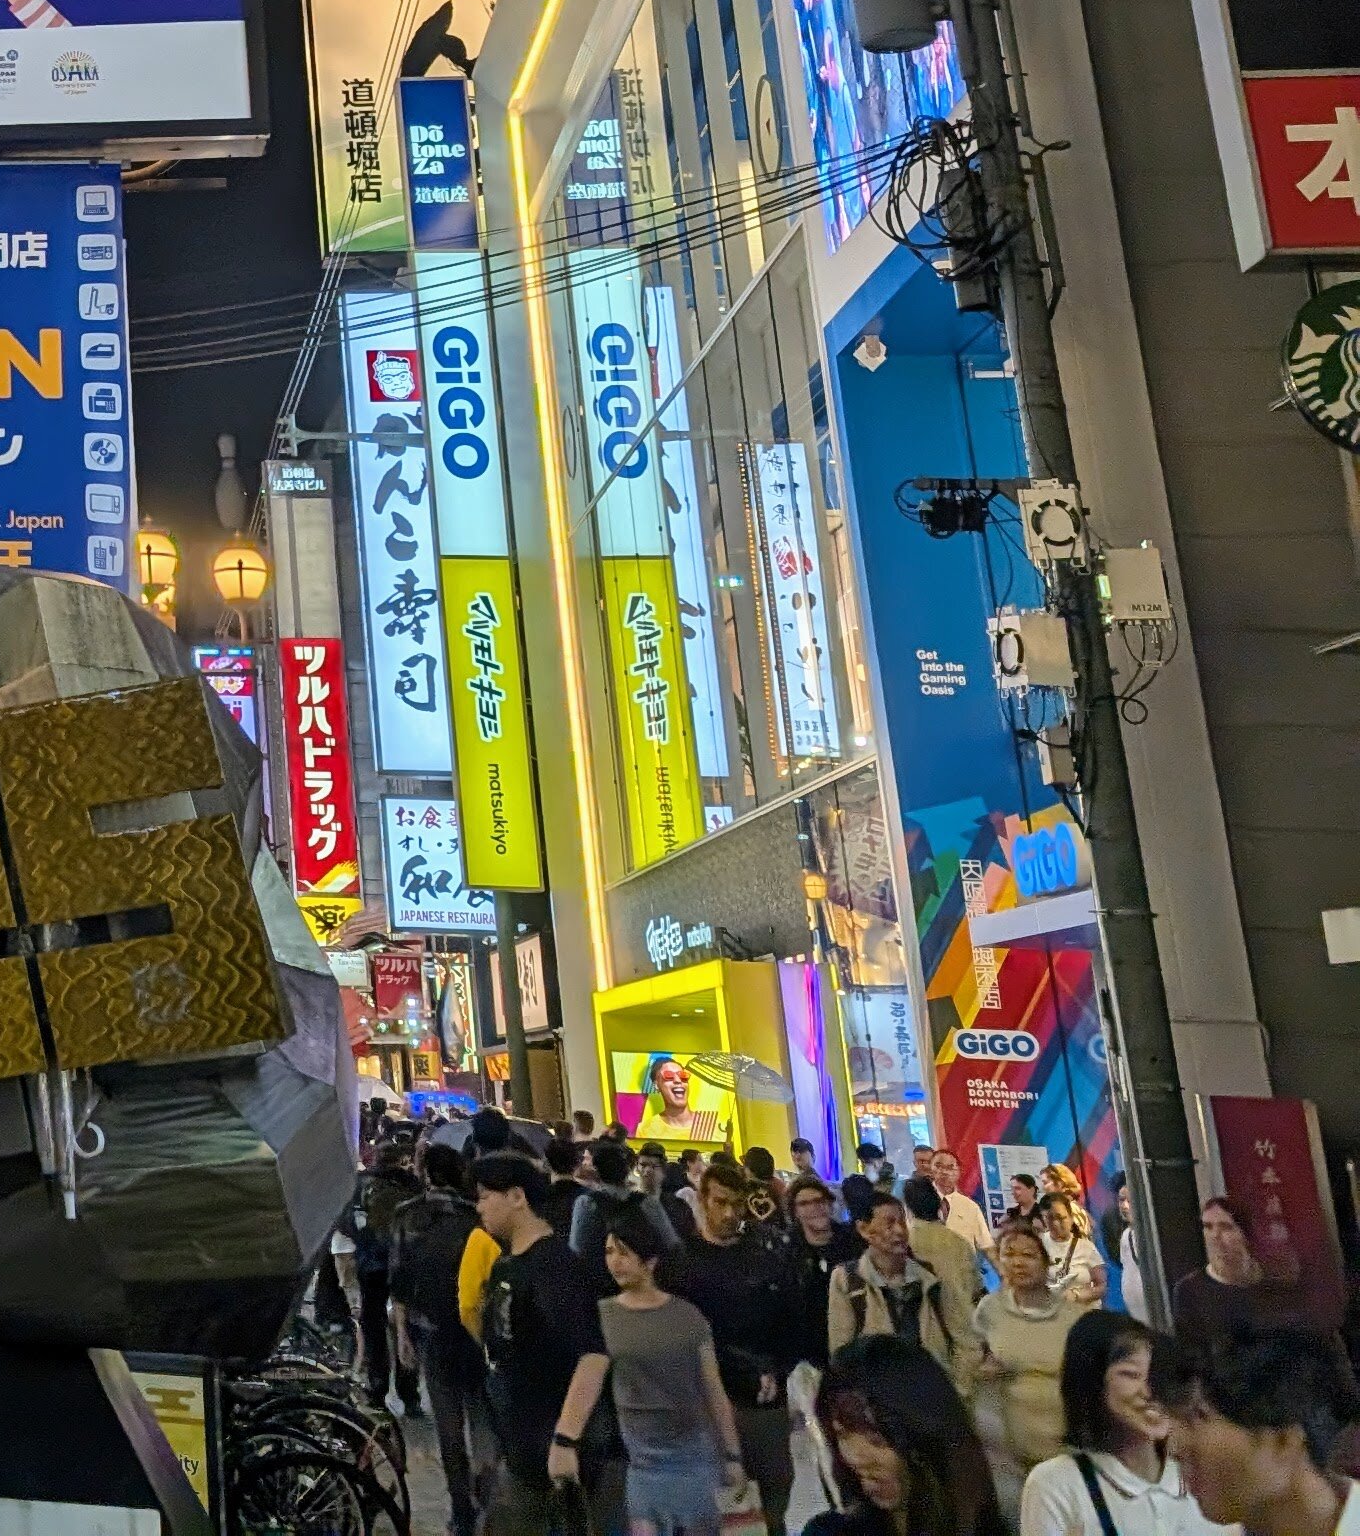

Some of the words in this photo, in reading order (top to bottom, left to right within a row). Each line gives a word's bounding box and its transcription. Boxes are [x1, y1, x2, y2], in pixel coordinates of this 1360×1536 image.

[341, 78, 382, 203] 道頓堀店
[411, 142, 466, 158] tone
[412, 157, 445, 175] Za
[432, 325, 491, 480] GiGO
[6, 511, 64, 536] Japan
[1131, 604, 1162, 612] M12M
[916, 650, 939, 661] Get
[464, 594, 504, 740] マツモトキヨシ
[921, 661, 943, 672] into
[945, 661, 964, 672] the
[920, 673, 966, 685] Gaming
[921, 685, 955, 695] Oasis
[293, 646, 342, 860] ツルハドラッグ
[487, 762, 508, 855] matsukiyo
[1013, 821, 1079, 897] GiGO
[400, 910, 446, 924] JAPANESE
[447, 912, 496, 925] RESTAURA
[375, 958, 420, 973] ツルハ
[377, 974, 412, 985] ドラッグ
[956, 1032, 1035, 1057] GiGO
[966, 1078, 1008, 1090] OSAKA
[968, 1088, 1040, 1101] DOTONBORI
[969, 1098, 1019, 1109] HONTEN
